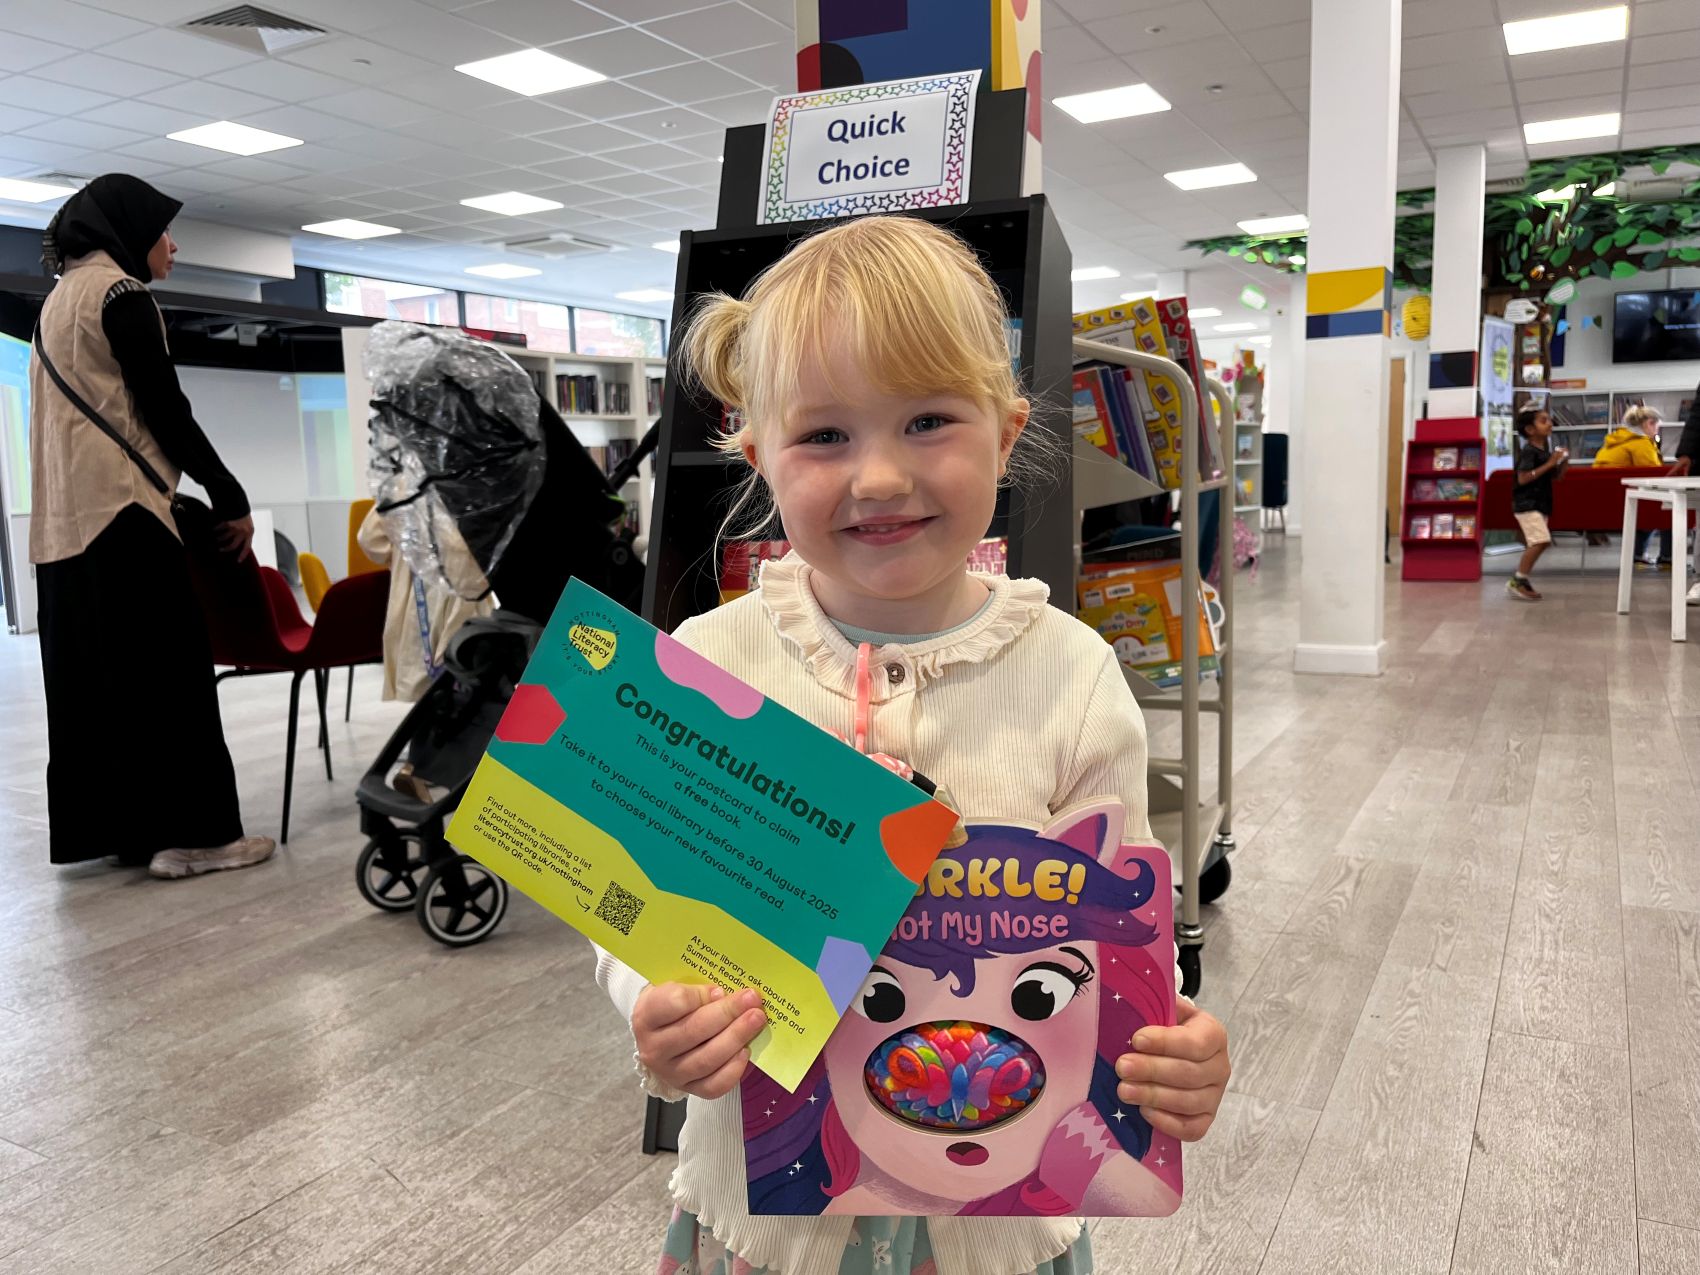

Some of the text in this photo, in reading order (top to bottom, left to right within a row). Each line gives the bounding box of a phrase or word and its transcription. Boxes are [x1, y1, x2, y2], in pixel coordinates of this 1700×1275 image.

[827, 110, 906, 144] Quick
[818, 155, 910, 185] Choice
[570, 637, 593, 658] Trust
[571, 629, 610, 659] Literacy
[576, 621, 615, 649] National
[615, 682, 856, 845] Congratulations!
[635, 733, 800, 846] This is your postcard to claim
[673, 781, 740, 829] a free book.
[473, 824, 544, 874] or use the QR code.
[482, 806, 582, 876] of participating libraries, at
[486, 795, 504, 811] Find
[503, 808, 516, 820] out
[516, 817, 538, 836] more,
[538, 830, 573, 859] including
[579, 857, 592, 870] list
[560, 733, 839, 920] Take it to your local library before 30 August 2025
[591, 778, 784, 911] to choose your new favourite read.
[477, 813, 593, 896] literacytrust.org.uk/nottingham
[914, 857, 1087, 905] RKLE!
[891, 910, 1070, 946] ot My Nose
[680, 952, 735, 994] how to becom
[686, 944, 718, 969] Summer
[760, 998, 788, 1022] allenge
[788, 1020, 805, 1034] and
[690, 935, 800, 1016] At your library, ask about the
